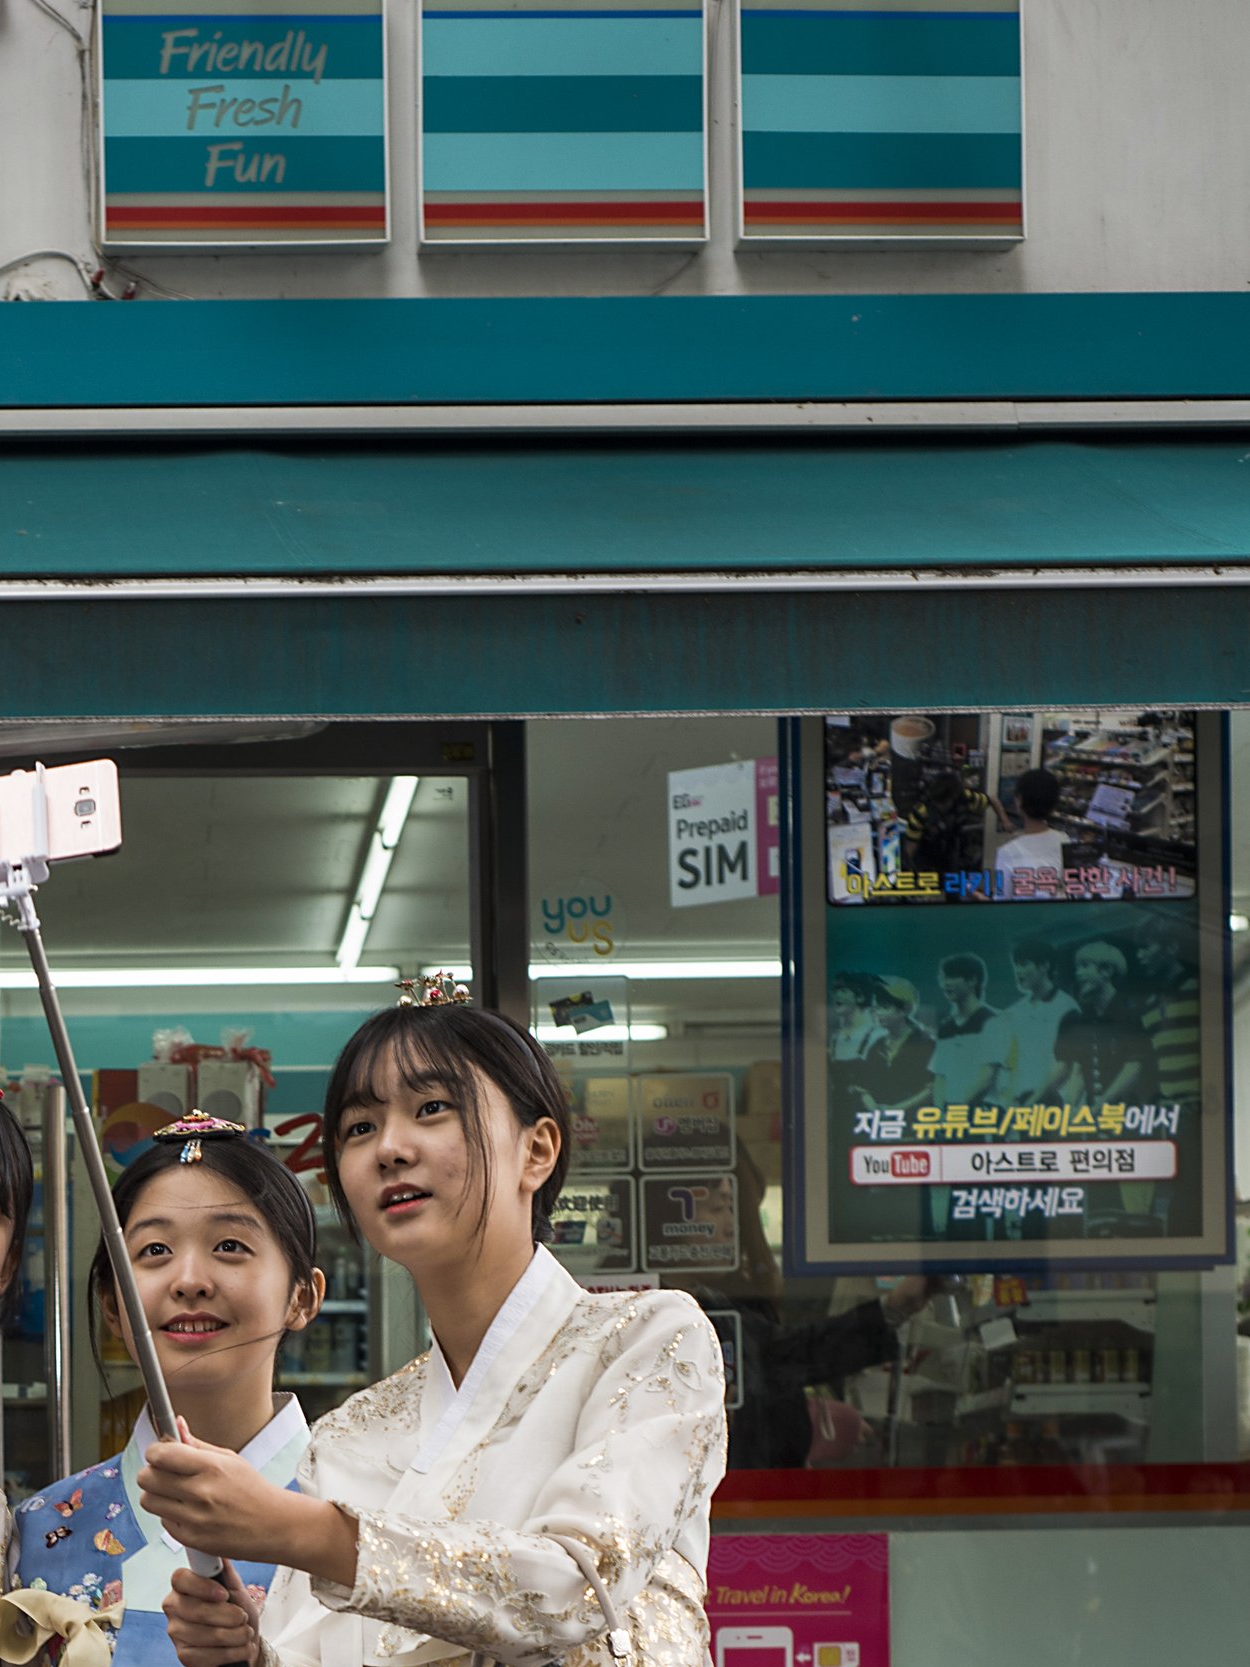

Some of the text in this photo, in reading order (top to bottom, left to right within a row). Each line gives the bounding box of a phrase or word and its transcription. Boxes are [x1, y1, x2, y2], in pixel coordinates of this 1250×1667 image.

[159, 28, 328, 84] Friendly
[186, 84, 303, 130] Fresh
[204, 141, 286, 187] Fun
[676, 810, 749, 840] Prepaid
[677, 841, 749, 890] SIM
[846, 871, 941, 898] 아스트로
[1012, 867, 1057, 897] 굴욕
[1062, 867, 1111, 895] 당한
[1120, 865, 1176, 893] 사건!
[542, 895, 612, 934] you
[566, 921, 614, 956] us
[854, 1103, 1180, 1140] 지금 유튜브/페이스북에서
[863, 1152, 930, 1177] YouTube
[971, 1147, 1136, 1174] 아스트로 편의점
[952, 1186, 1085, 1219] 검색하세요
[662, 1222, 717, 1237] money
[716, 1585, 769, 1605] Travel
[770, 1585, 787, 1605] in
[789, 1582, 852, 1605] Korea!
